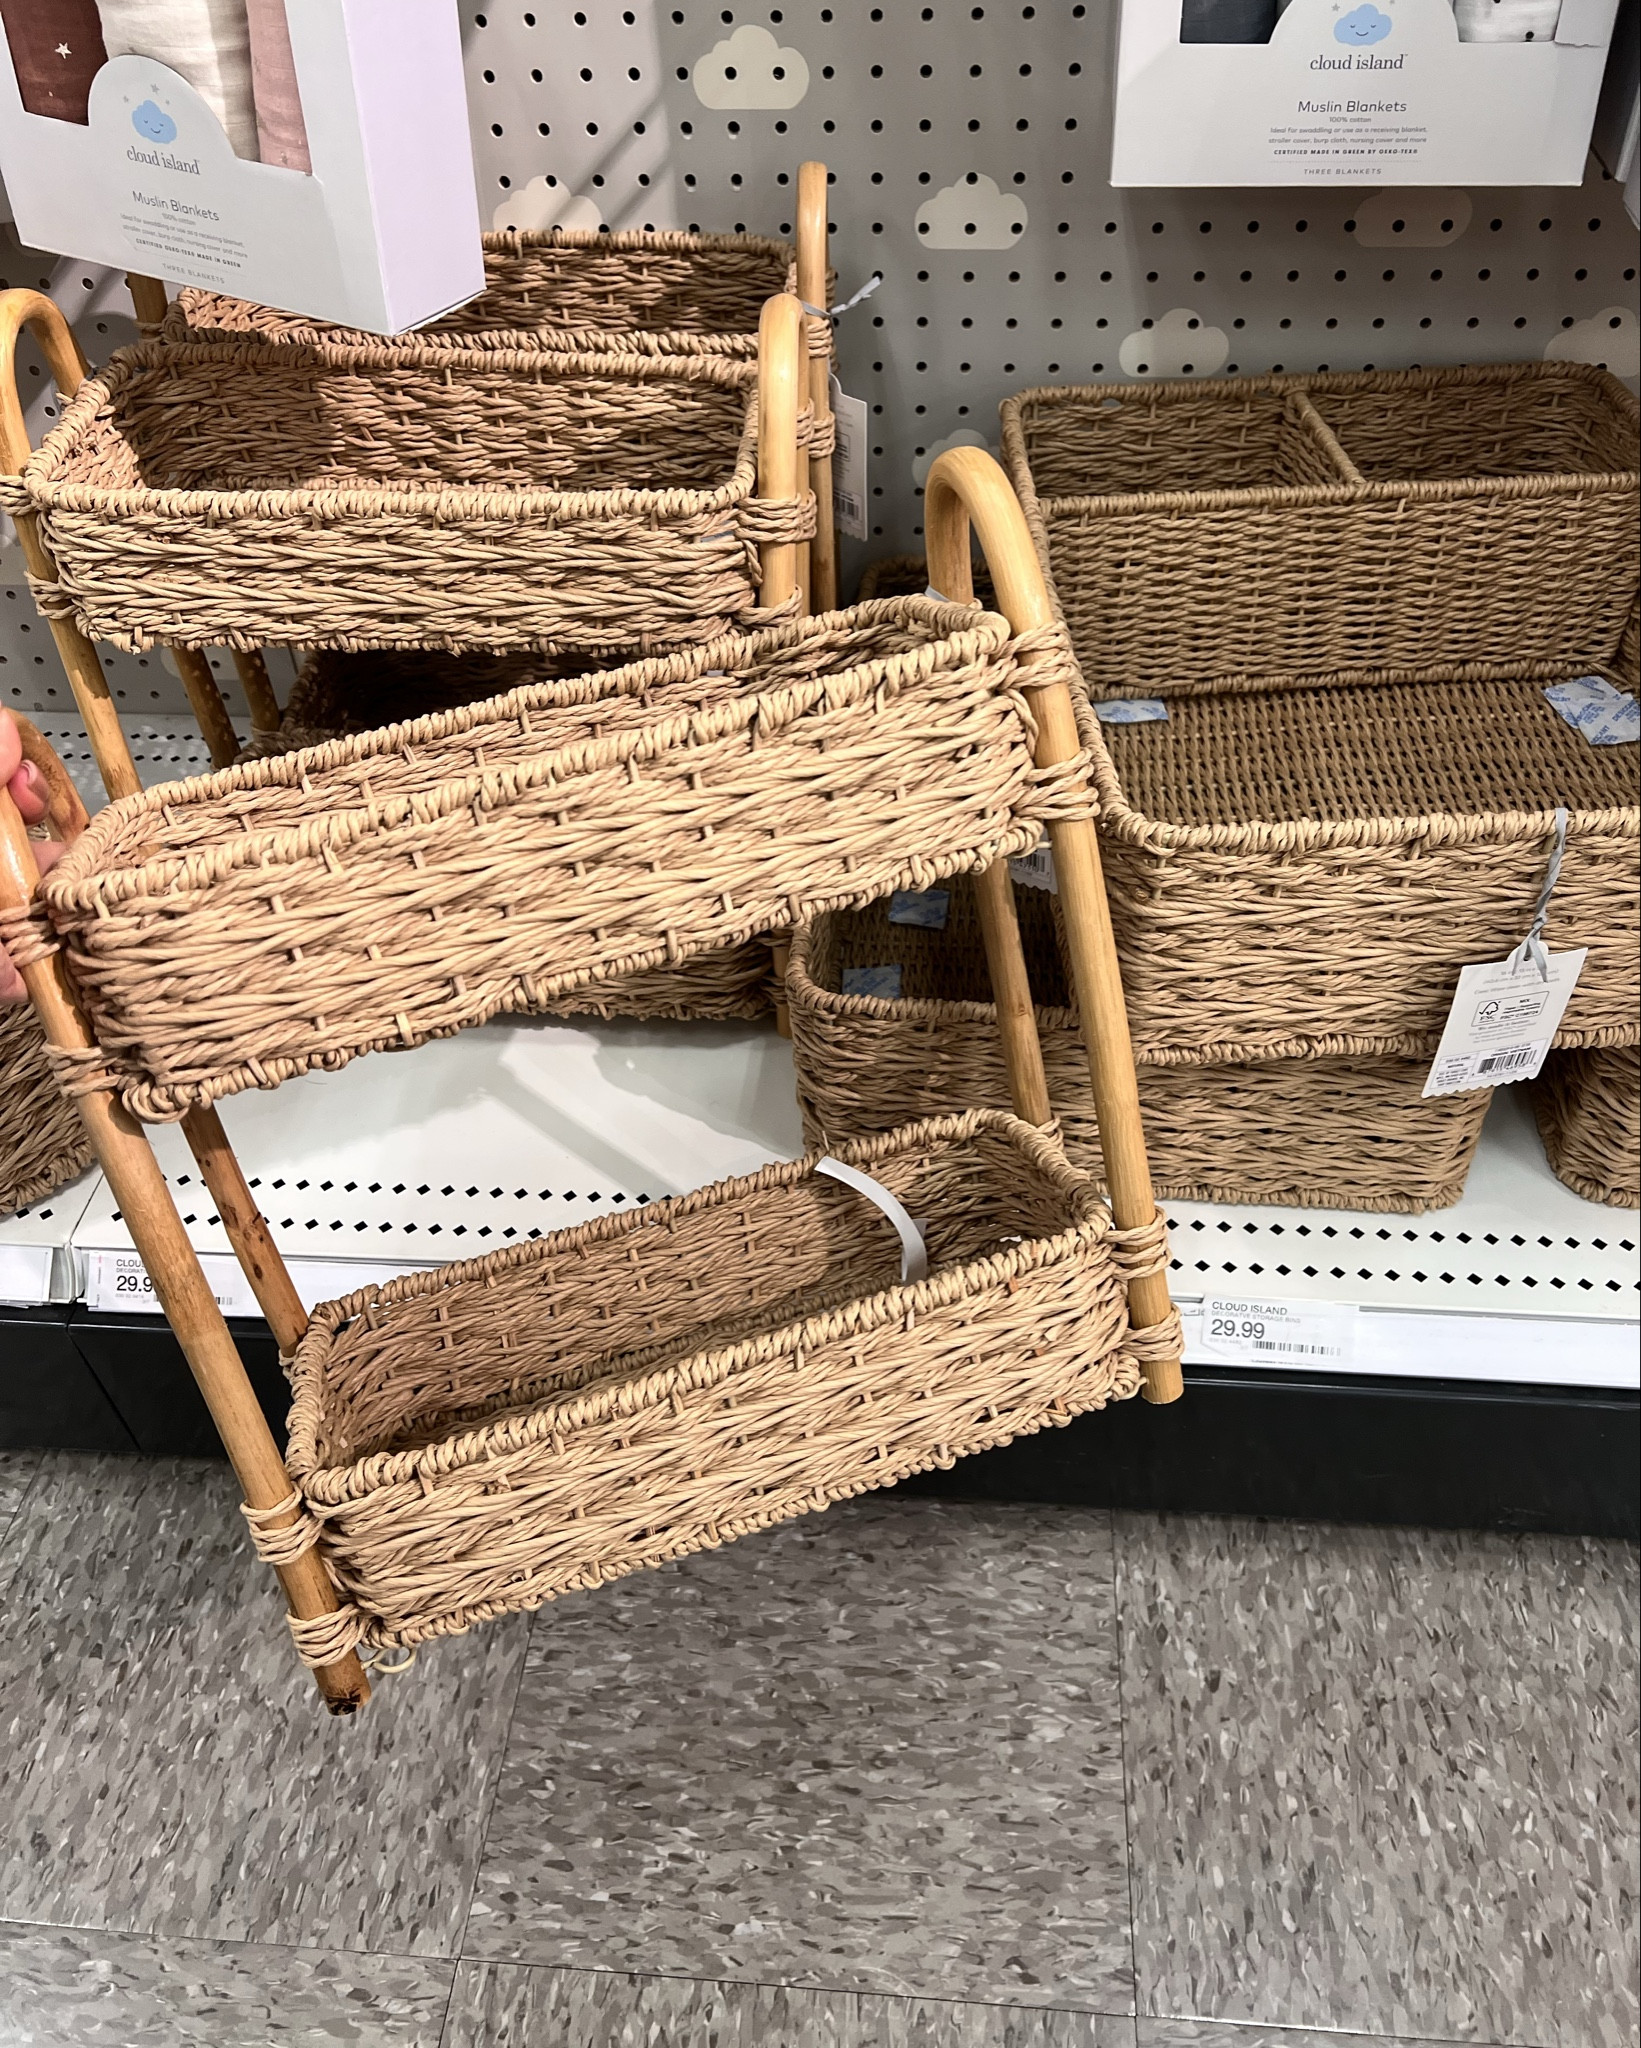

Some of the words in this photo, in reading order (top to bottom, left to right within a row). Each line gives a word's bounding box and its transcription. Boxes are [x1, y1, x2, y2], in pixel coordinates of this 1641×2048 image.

[1310, 54, 1351, 70] cloud
[1298, 101, 1342, 113] Muslin
[1346, 100, 1408, 113] Blankets
[1299, 126, 1333, 135] swaddling
[126, 145, 161, 167] cloud
[160, 152, 200, 175] island
[132, 190, 169, 210] Muslin
[170, 199, 220, 221] Blankets
[162, 262, 186, 274] THREE
[187, 269, 225, 284] BLANKETS
[116, 1259, 145, 1267] CLOU
[116, 1276, 152, 1292] 29.9
[1212, 1301, 1248, 1312] CLOUD
[1250, 1304, 1288, 1316] ISLAND
[1211, 1318, 1265, 1340] 29.99
